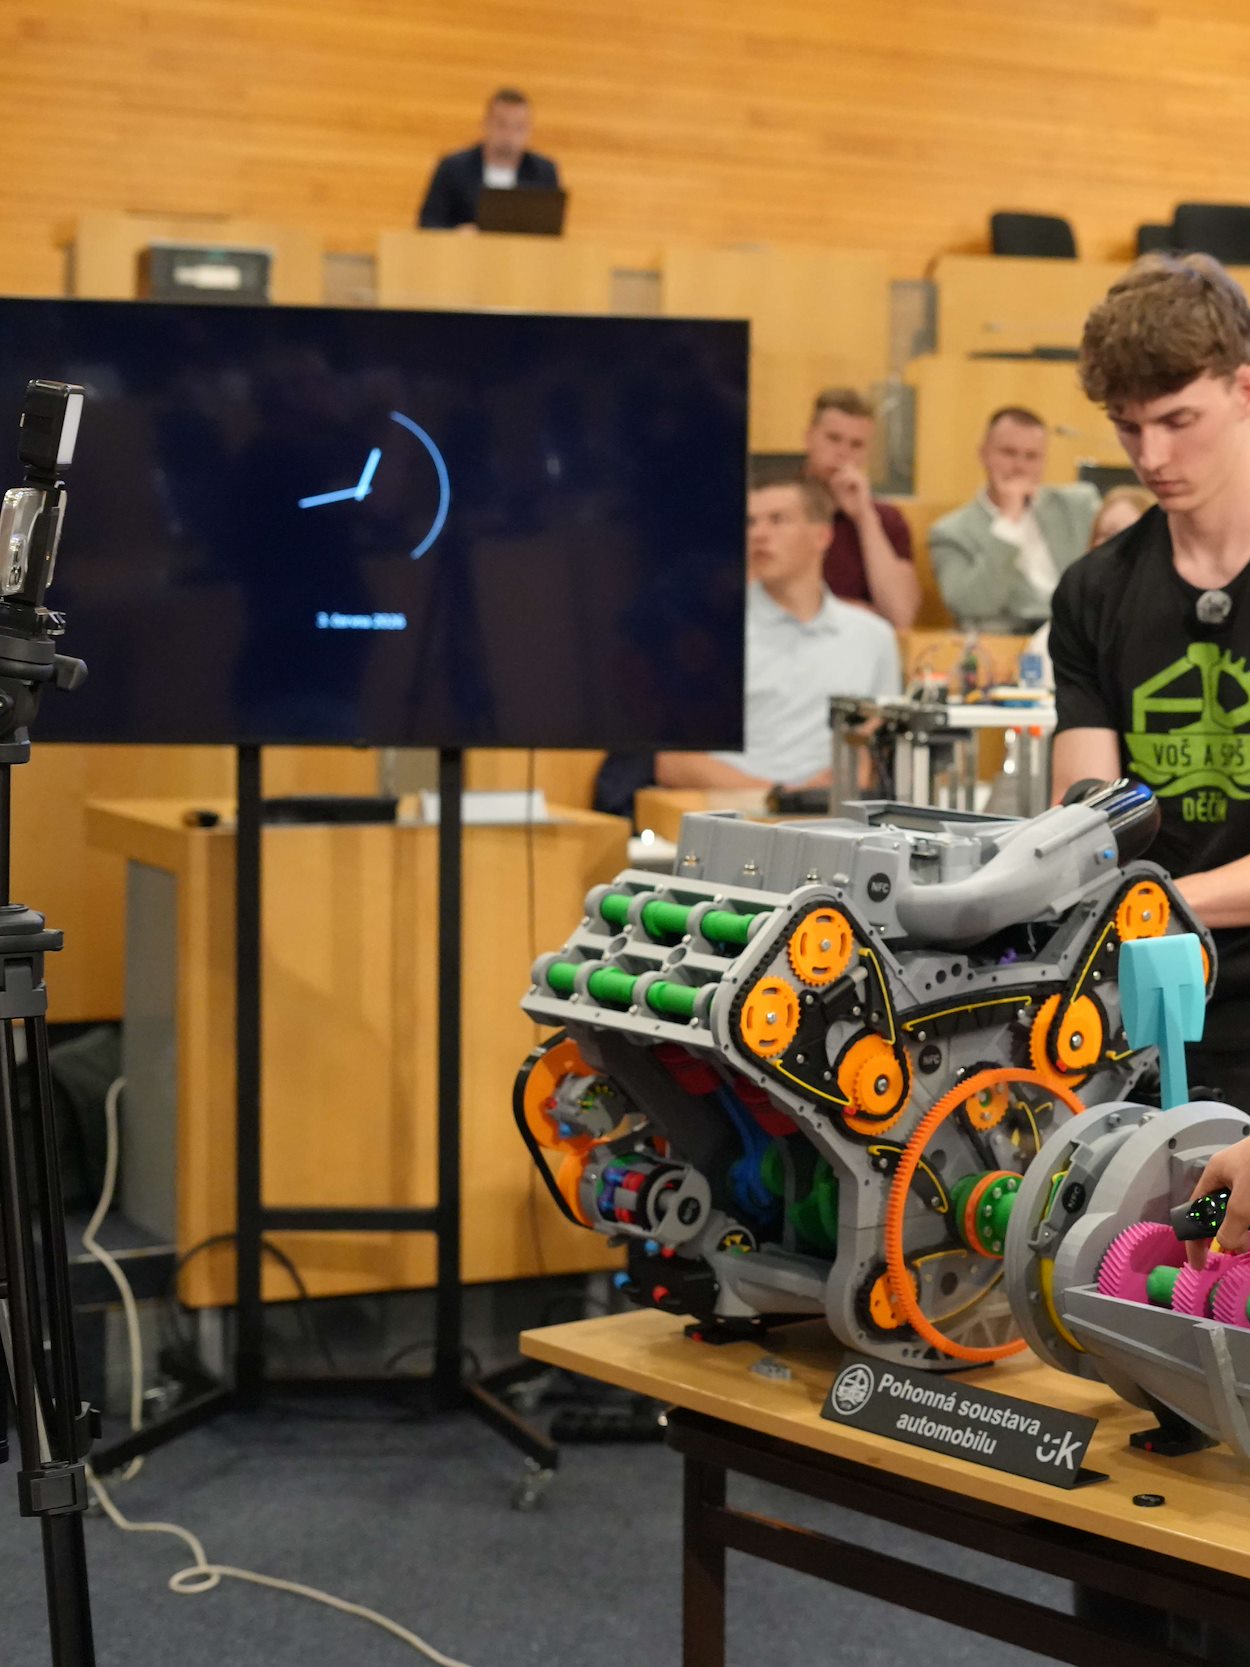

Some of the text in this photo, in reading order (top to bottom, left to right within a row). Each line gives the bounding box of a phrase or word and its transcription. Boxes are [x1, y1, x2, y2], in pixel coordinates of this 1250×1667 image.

[1153, 739, 1192, 767] VOŠ
[1204, 745, 1215, 767] A
[877, 1373, 957, 1412] Pohonná
[957, 1399, 1041, 1436] soustava
[896, 1412, 998, 1455] automobilu
